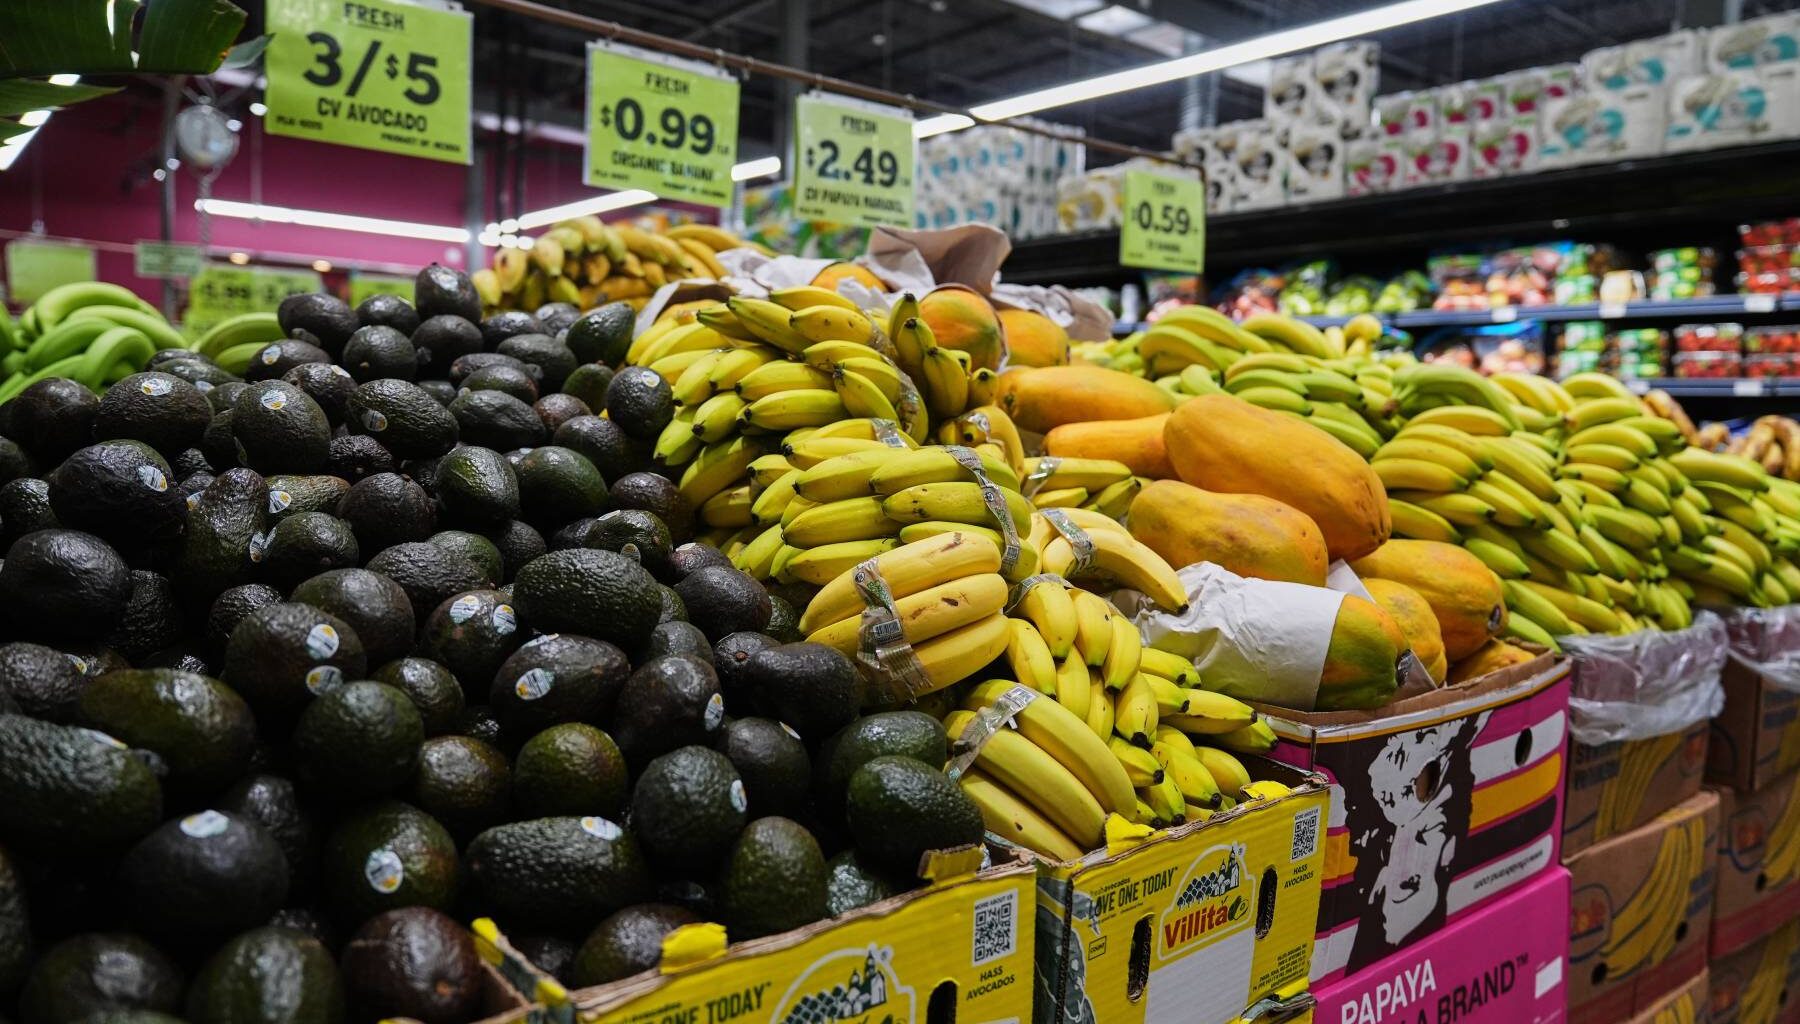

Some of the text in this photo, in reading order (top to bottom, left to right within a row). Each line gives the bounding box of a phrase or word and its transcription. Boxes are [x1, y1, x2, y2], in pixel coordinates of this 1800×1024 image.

[344, 3, 404, 30] FRESH
[645, 72, 689, 94] FRESH
[317, 97, 341, 118] CV
[347, 104, 427, 133] AVOCADO
[601, 97, 714, 155] $0.99
[612, 151, 666, 173] ORGANIC
[807, 140, 897, 188] $2.49
[1284, 870, 1314, 888] AVOCADOS
[1293, 863, 1308, 875] HASS
[1118, 882, 1140, 908] ONE
[980, 965, 1003, 982] HASS
[966, 975, 1015, 1000] AVOCADOS
[1341, 959, 1437, 1024] PAPAYA
